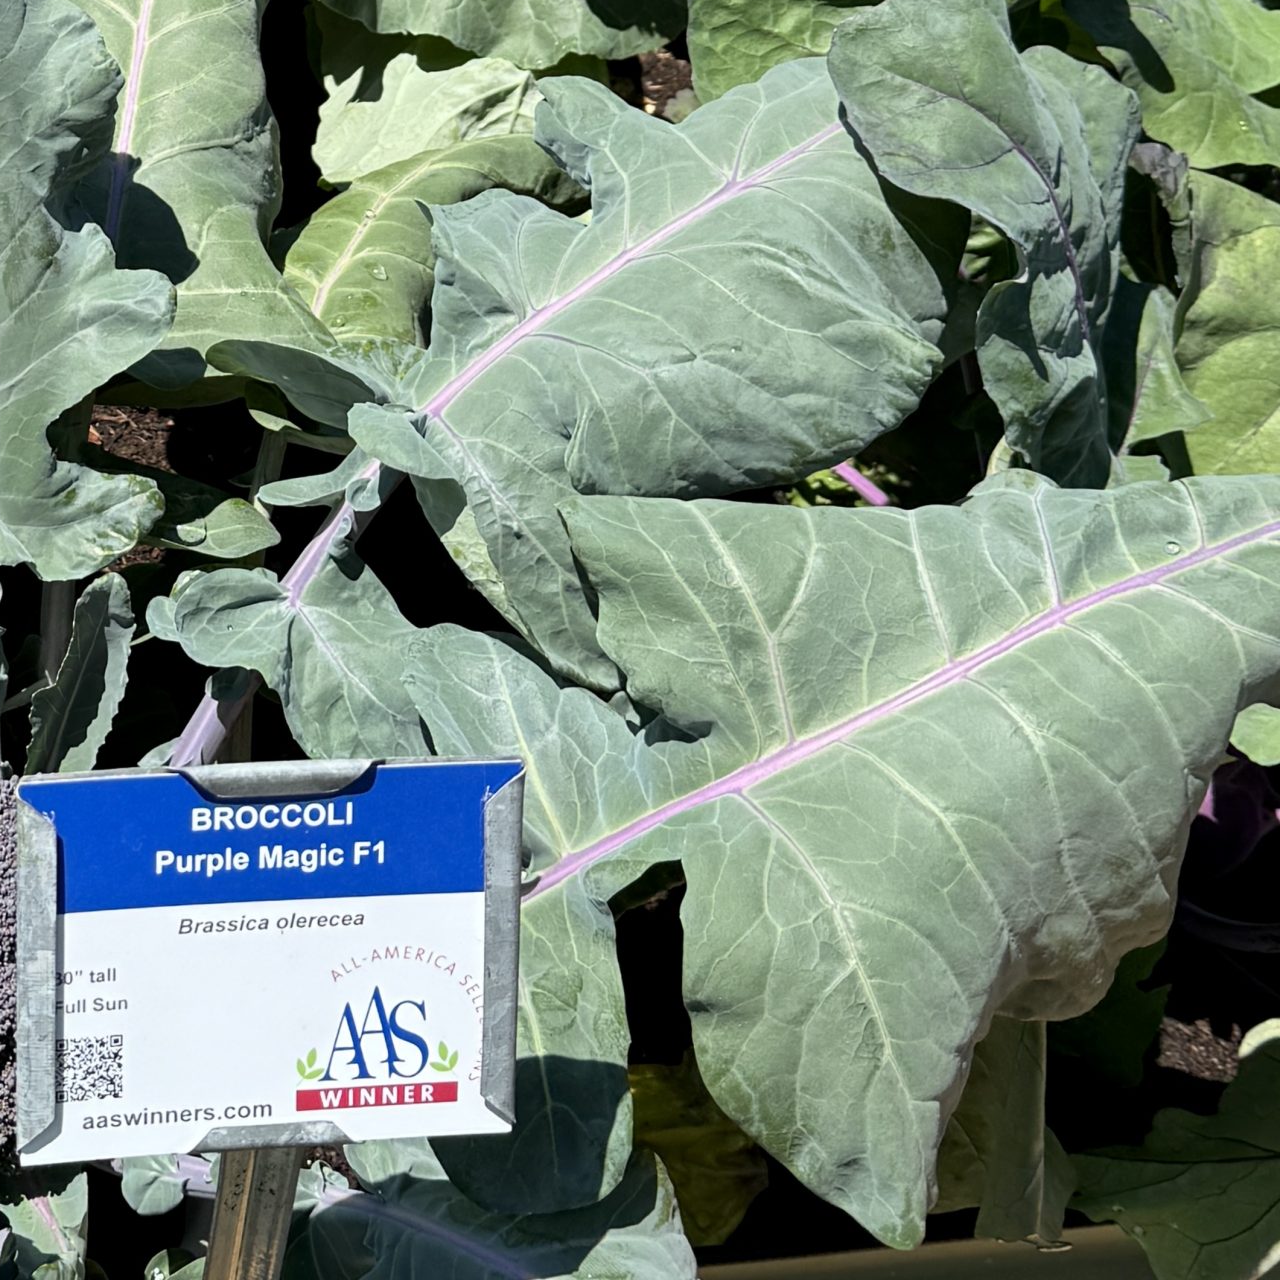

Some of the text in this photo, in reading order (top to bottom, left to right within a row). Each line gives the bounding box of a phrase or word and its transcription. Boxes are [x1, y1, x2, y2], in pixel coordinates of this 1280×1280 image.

[191, 801, 353, 832] BROCCOLI
[155, 840, 386, 878] Purple Magic F1
[178, 912, 365, 935] Brassica olerecea
[89, 967, 117, 983] tall
[331, 946, 457, 982] ALL-AMERICA
[92, 997, 128, 1012] Sun
[318, 985, 429, 1081] AAS
[320, 1084, 434, 1109] WINNER
[81, 1102, 273, 1130] aaswinners.com
